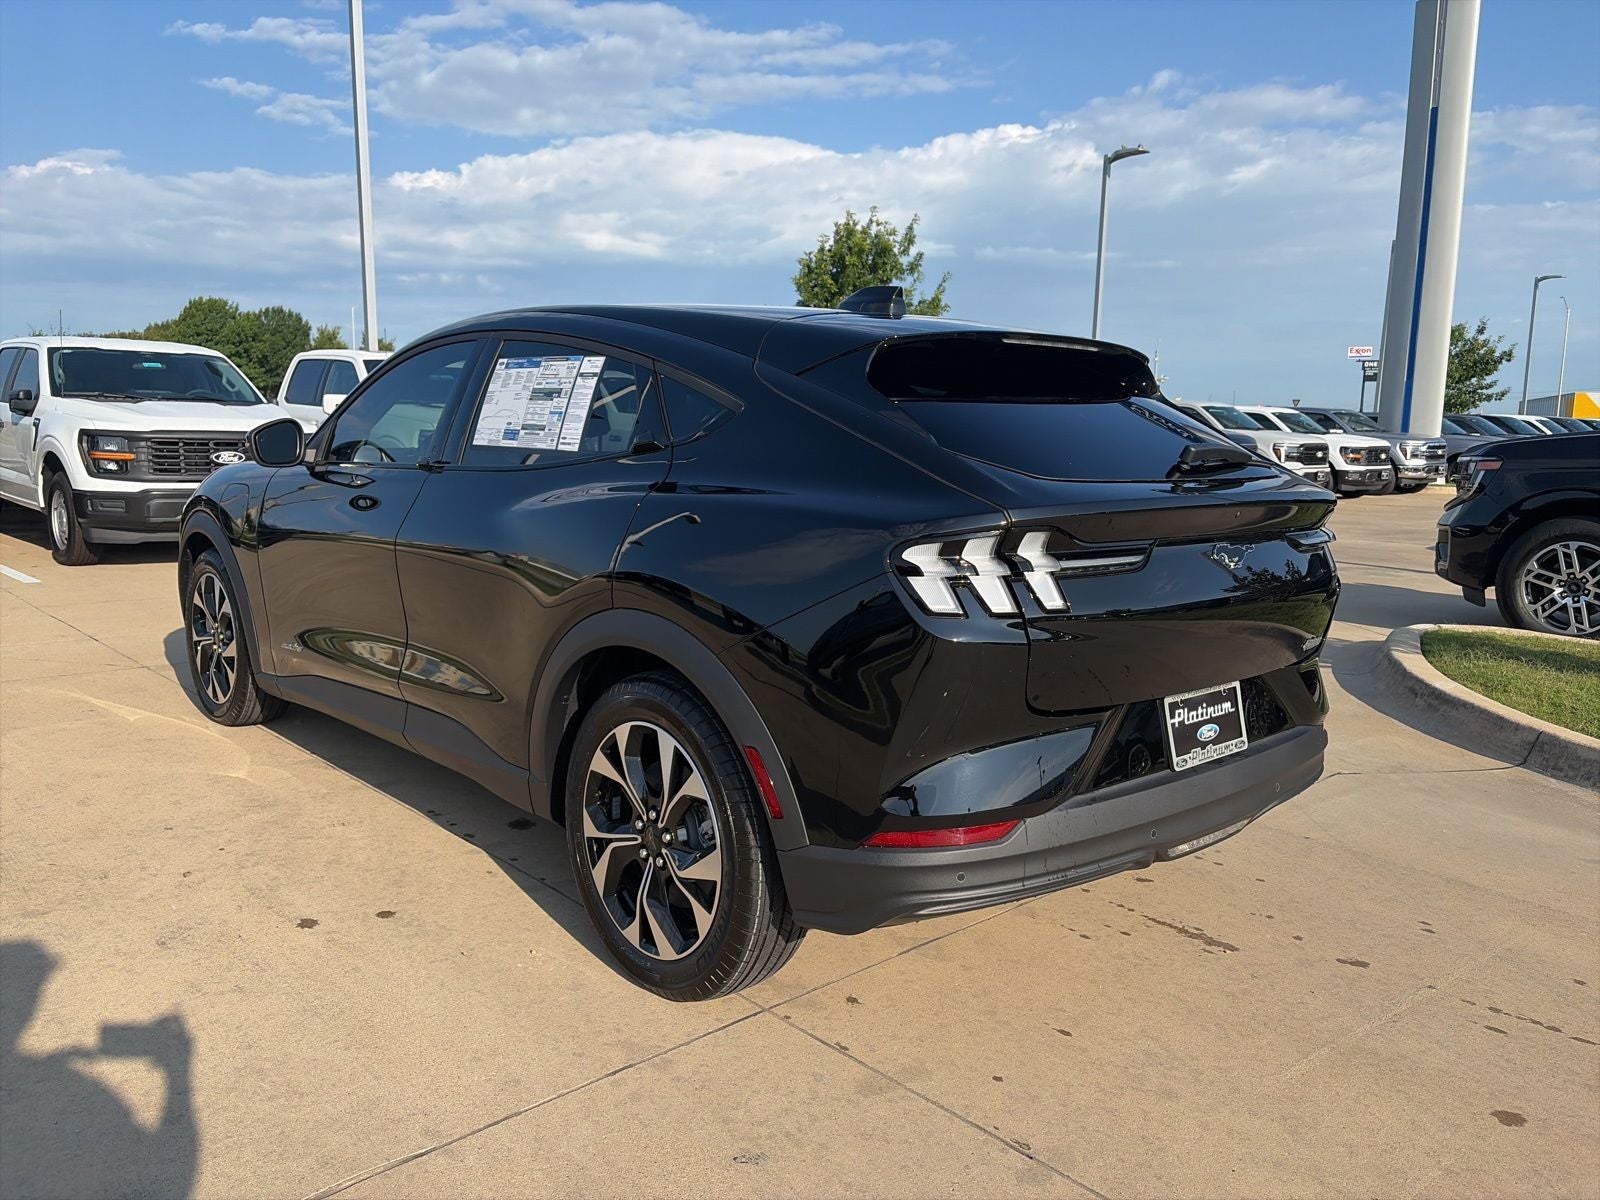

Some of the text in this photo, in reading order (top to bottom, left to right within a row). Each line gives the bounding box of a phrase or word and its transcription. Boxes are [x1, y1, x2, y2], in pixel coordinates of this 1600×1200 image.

[1349, 347, 1371, 355] Exxon
[1170, 700, 1236, 728] Platinum
[1190, 744, 1233, 762] Platinum
